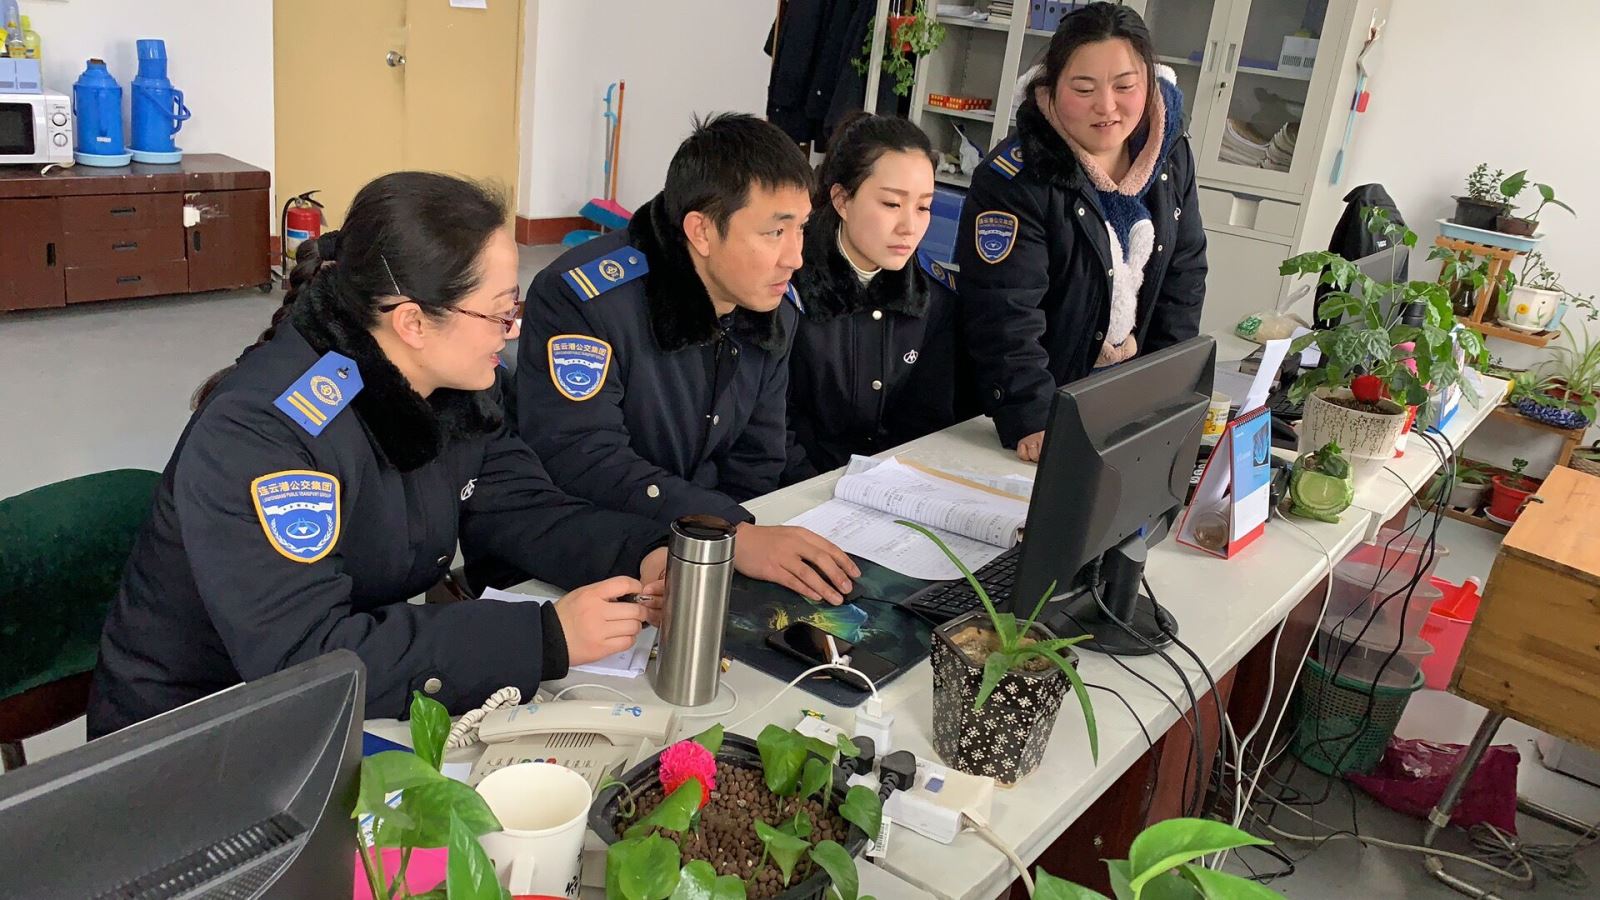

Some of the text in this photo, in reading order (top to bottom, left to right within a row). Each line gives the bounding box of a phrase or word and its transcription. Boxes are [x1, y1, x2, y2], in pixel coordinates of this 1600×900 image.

[257, 480, 332, 496] 连云港公交集团
